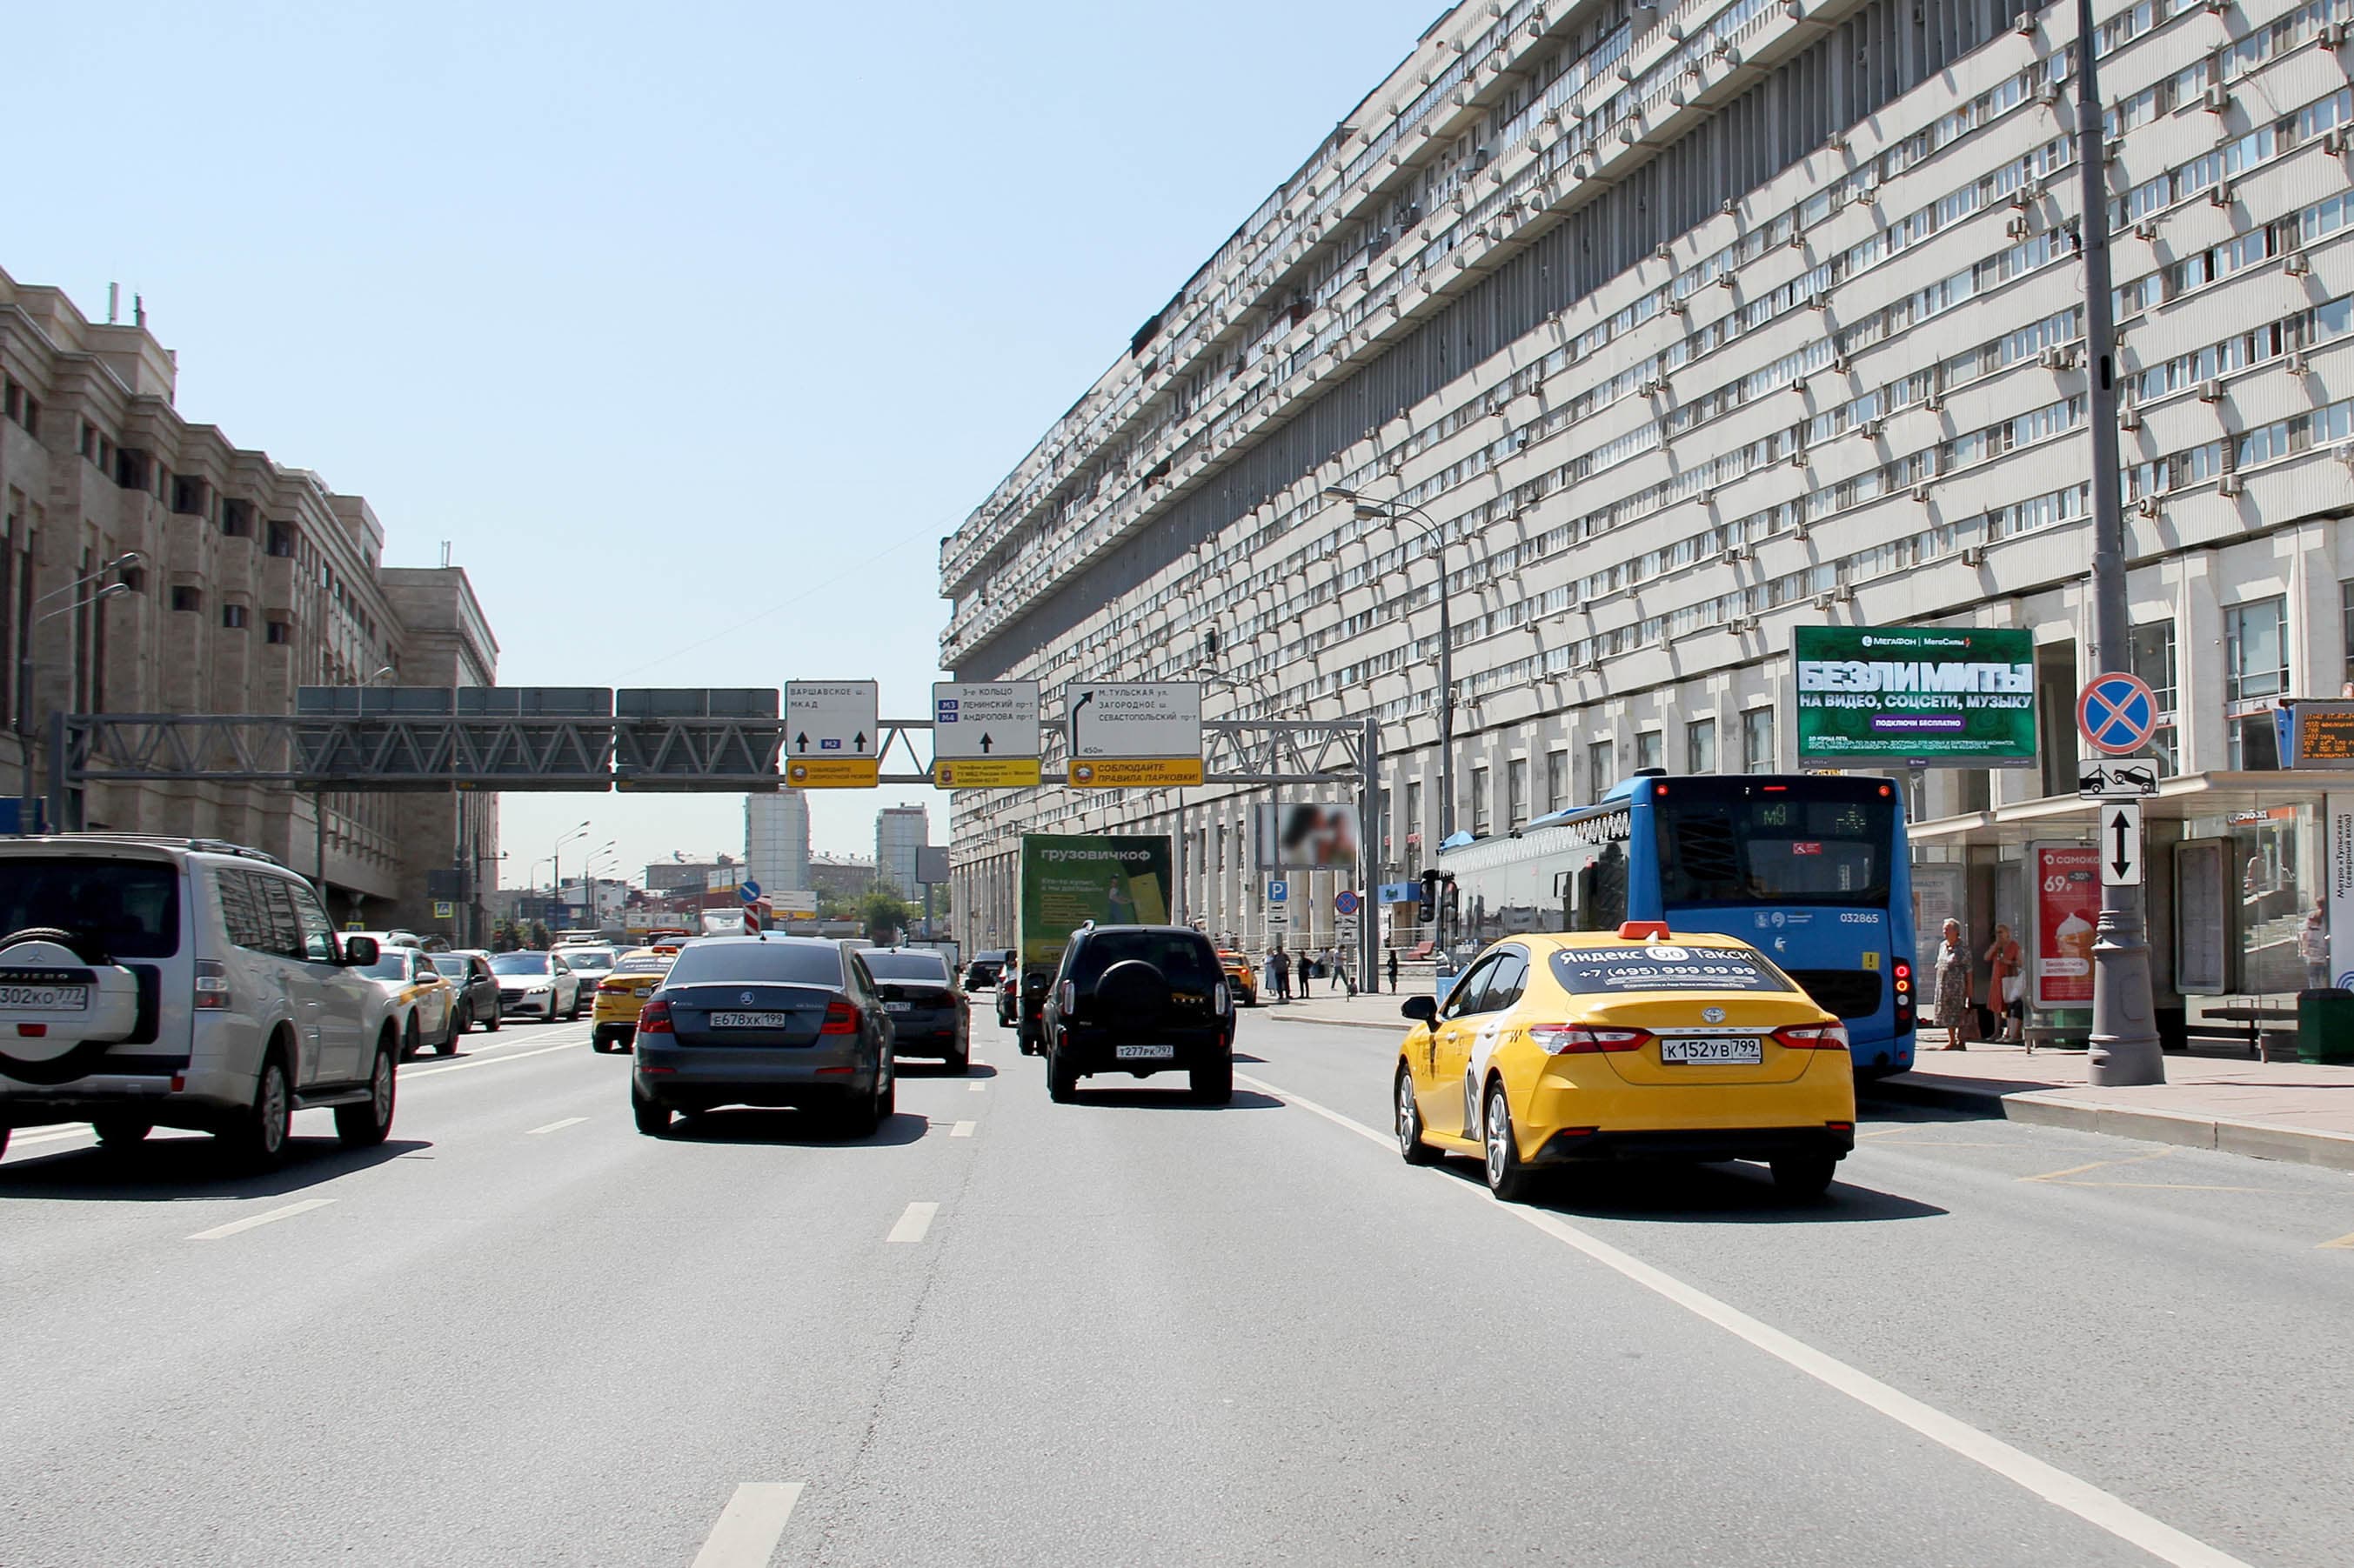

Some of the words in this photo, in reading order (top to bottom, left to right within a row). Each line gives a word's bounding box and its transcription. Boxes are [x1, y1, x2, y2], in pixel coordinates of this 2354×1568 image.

[1798, 661, 2033, 693] БЕЗЛИМИТЫ
[980, 688, 1013, 697] КОЛЬЦО
[963, 699, 1013, 709] ЛЕНИНСКИЙ
[1800, 695, 1821, 708] НА
[1824, 695, 1882, 711] ВИДЕО,
[1884, 695, 1963, 711] СОЦСЕТИ,
[1965, 695, 2032, 709] МУЗЫКУ
[1016, 713, 1033, 722] пр-т
[1099, 711, 1177, 722] СЕВАСТОПОЛЬСКИЙ
[1098, 763, 1166, 773] СОБЛЮДАЙТЕ
[1098, 774, 1142, 783] ПРАВИЛА
[1145, 773, 1199, 782] ПАРКОВКИ!
[2344, 814, 2352, 837] вход)
[2336, 814, 2345, 865] «Тульская»
[1040, 850, 1151, 862] грузовичкоф
[2344, 839, 2353, 888] (северный
[2337, 866, 2345, 898] Метро
[1840, 913, 1879, 924] 032865
[1561, 949, 1644, 965] Яндекс
[1689, 947, 1754, 961] Такси
[1579, 968, 1602, 978] +7
[1607, 966, 1659, 977] (495)
[1662, 965, 1701, 976] 999
[1702, 965, 1729, 976] 99
[1732, 966, 1757, 977] 99
[57, 987, 83, 1000] 777
[714, 1014, 761, 1026] Е678ХК
[764, 1013, 783, 1024] 199
[1120, 1046, 1156, 1058] Т277РК
[1667, 1041, 1730, 1058] К152УВ
[1731, 1039, 1756, 1053] 799
